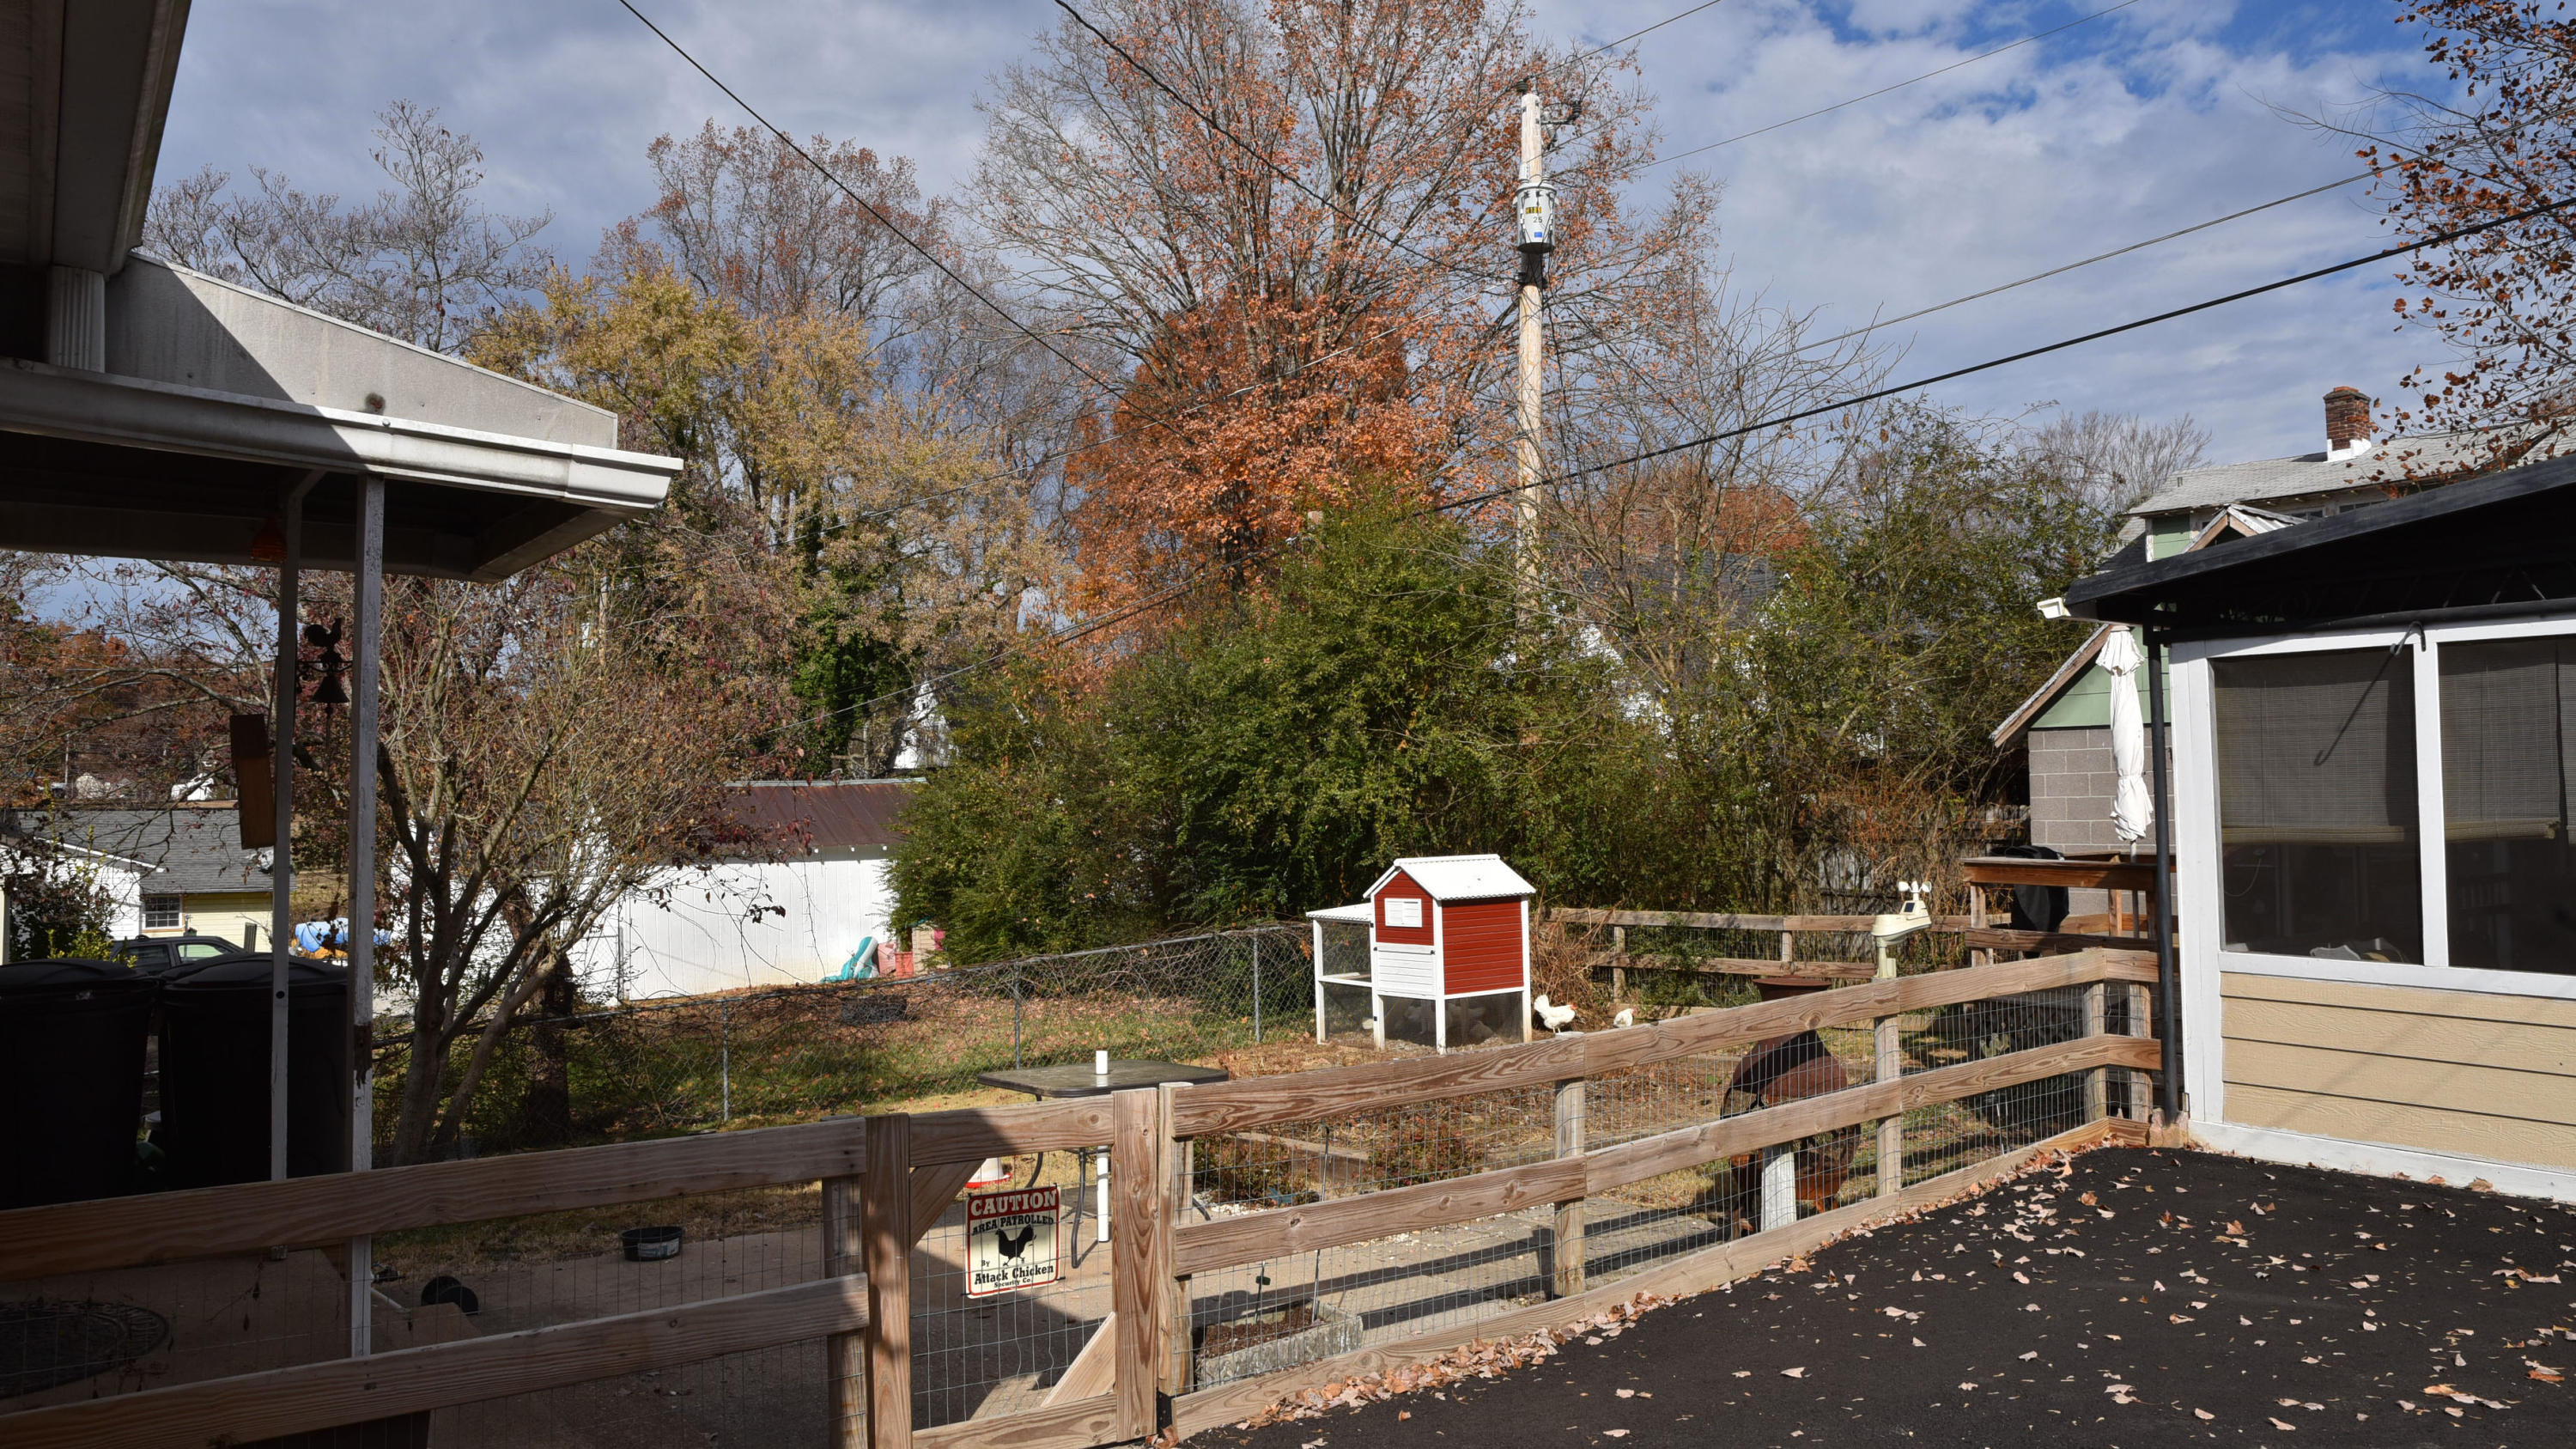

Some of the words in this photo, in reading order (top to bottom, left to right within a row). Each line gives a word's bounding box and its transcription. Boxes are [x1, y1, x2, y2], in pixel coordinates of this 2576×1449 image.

[971, 1190, 1056, 1216] CAUTION
[972, 1221, 998, 1236] AREA
[1000, 1215, 1054, 1227] PATROLLED
[975, 1270, 1008, 1285] Attack
[1012, 1264, 1054, 1279] Chicken
[994, 1279, 1020, 1288] Security
